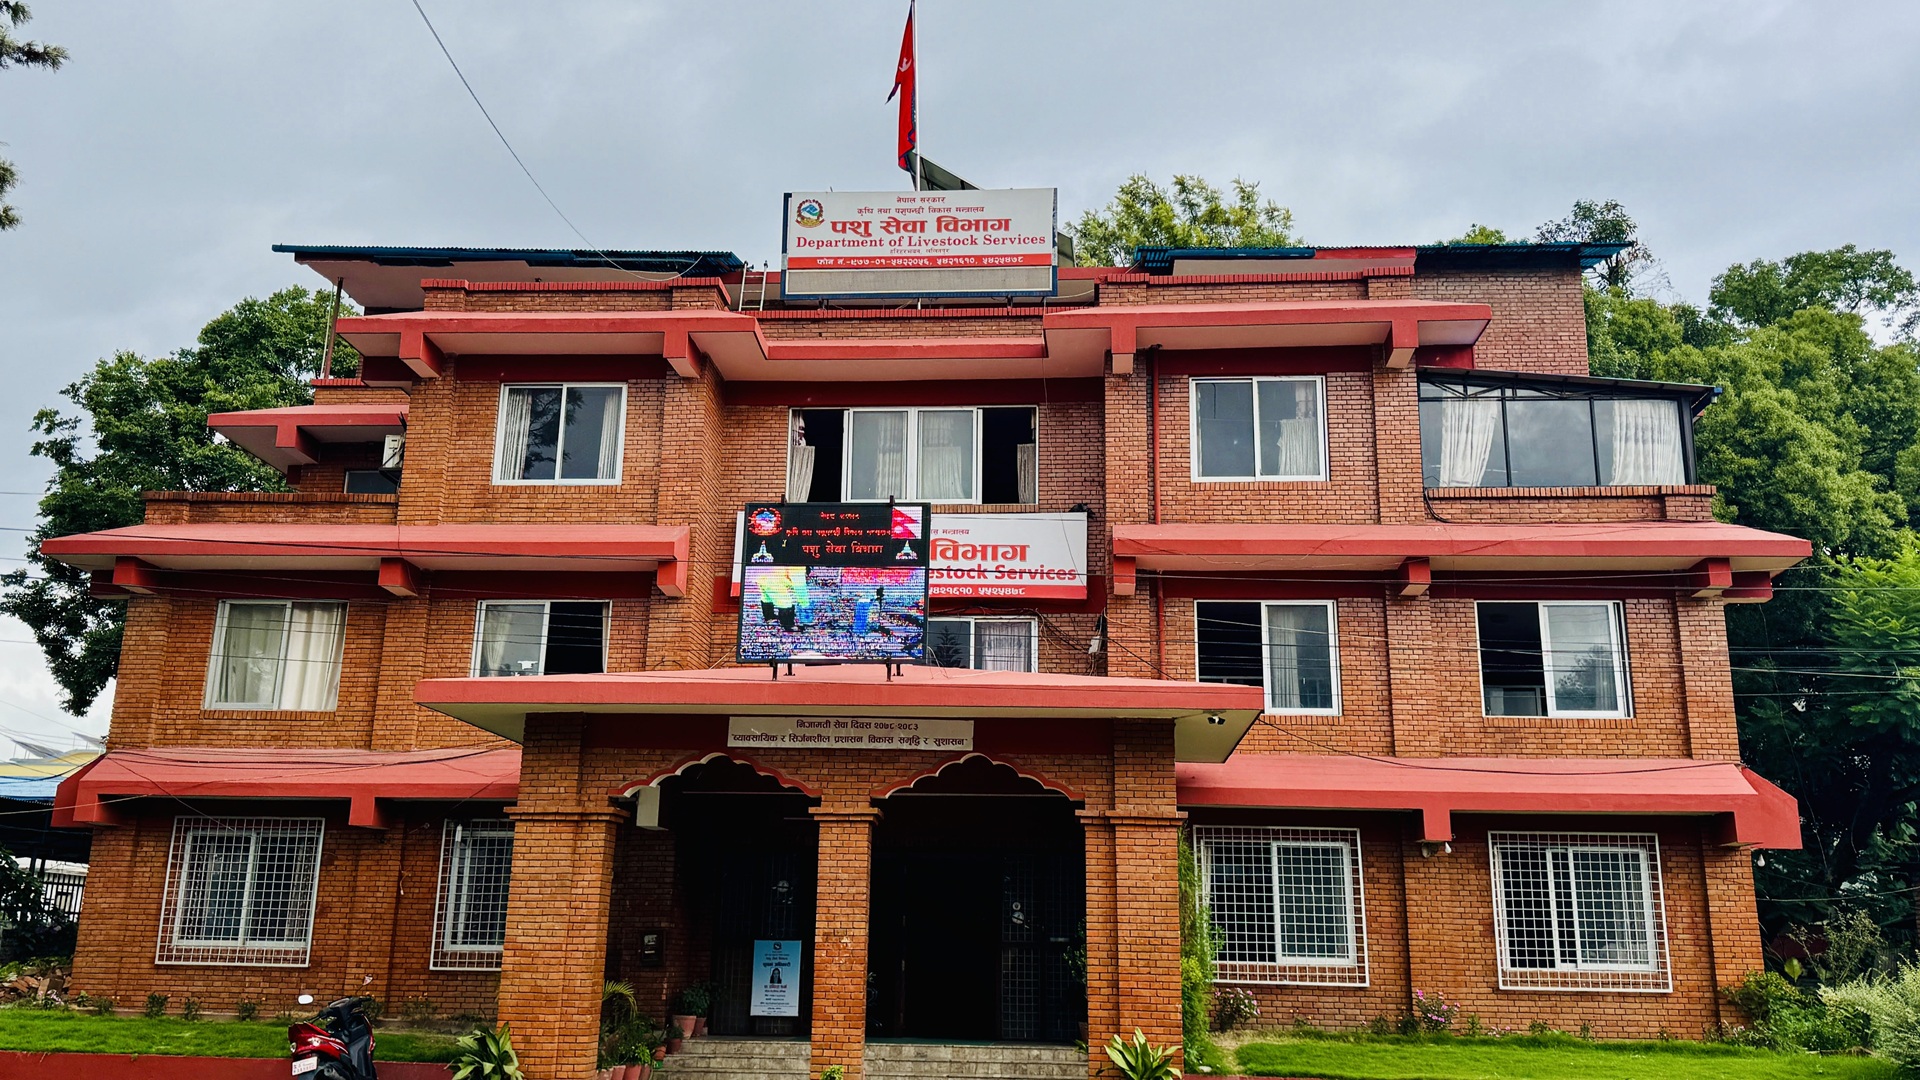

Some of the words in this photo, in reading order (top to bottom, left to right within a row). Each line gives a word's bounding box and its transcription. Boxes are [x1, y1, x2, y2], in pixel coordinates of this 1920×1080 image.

[896, 196, 916, 204] नेपाल
[830, 219, 872, 237] पशु
[879, 216, 928, 234] सेवा
[936, 215, 1012, 233] विभाग
[796, 236, 884, 249] Department
[888, 235, 903, 247] of
[907, 234, 979, 247] Livestock
[983, 234, 1046, 245] Services
[930, 537, 1030, 562] विभाग
[929, 564, 988, 580] estock
[994, 564, 1077, 580] Services
[796, 719, 831, 729] निजामती
[833, 719, 849, 729] सेवा
[850, 719, 872, 730] दिवस
[780, 735, 787, 743] र
[833, 735, 864, 744] प्रशासन
[868, 734, 894, 744] विकास
[922, 737, 930, 745] र
